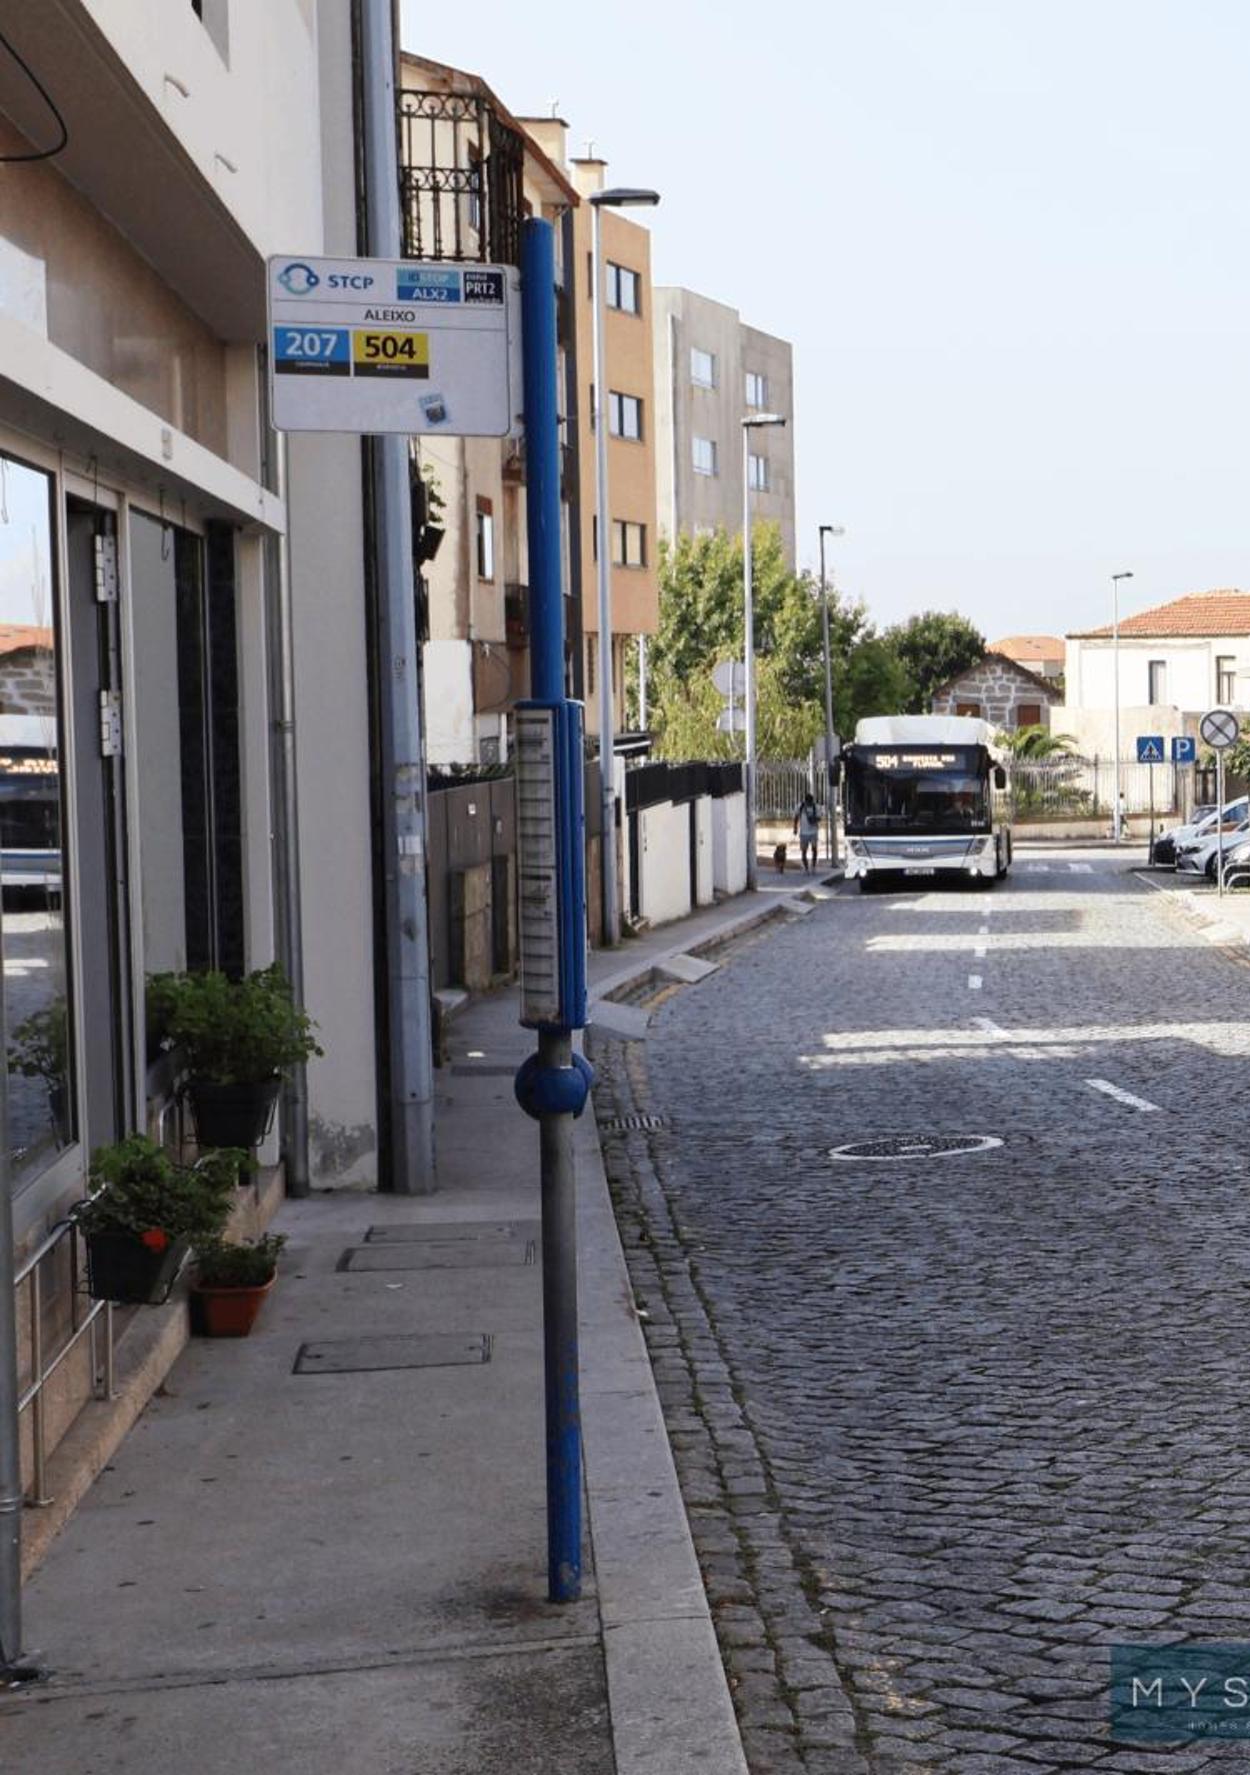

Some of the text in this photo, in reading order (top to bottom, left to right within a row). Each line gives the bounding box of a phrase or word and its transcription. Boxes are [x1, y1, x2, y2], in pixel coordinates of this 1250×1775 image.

[327, 275, 374, 290] STCP
[466, 281, 496, 295] PRT2
[412, 287, 449, 300] ALX2
[363, 309, 416, 322] ALEIXO
[285, 332, 338, 356] 207
[364, 335, 417, 359] 504
[1176, 739, 1190, 759] P
[875, 754, 898, 769] 504
